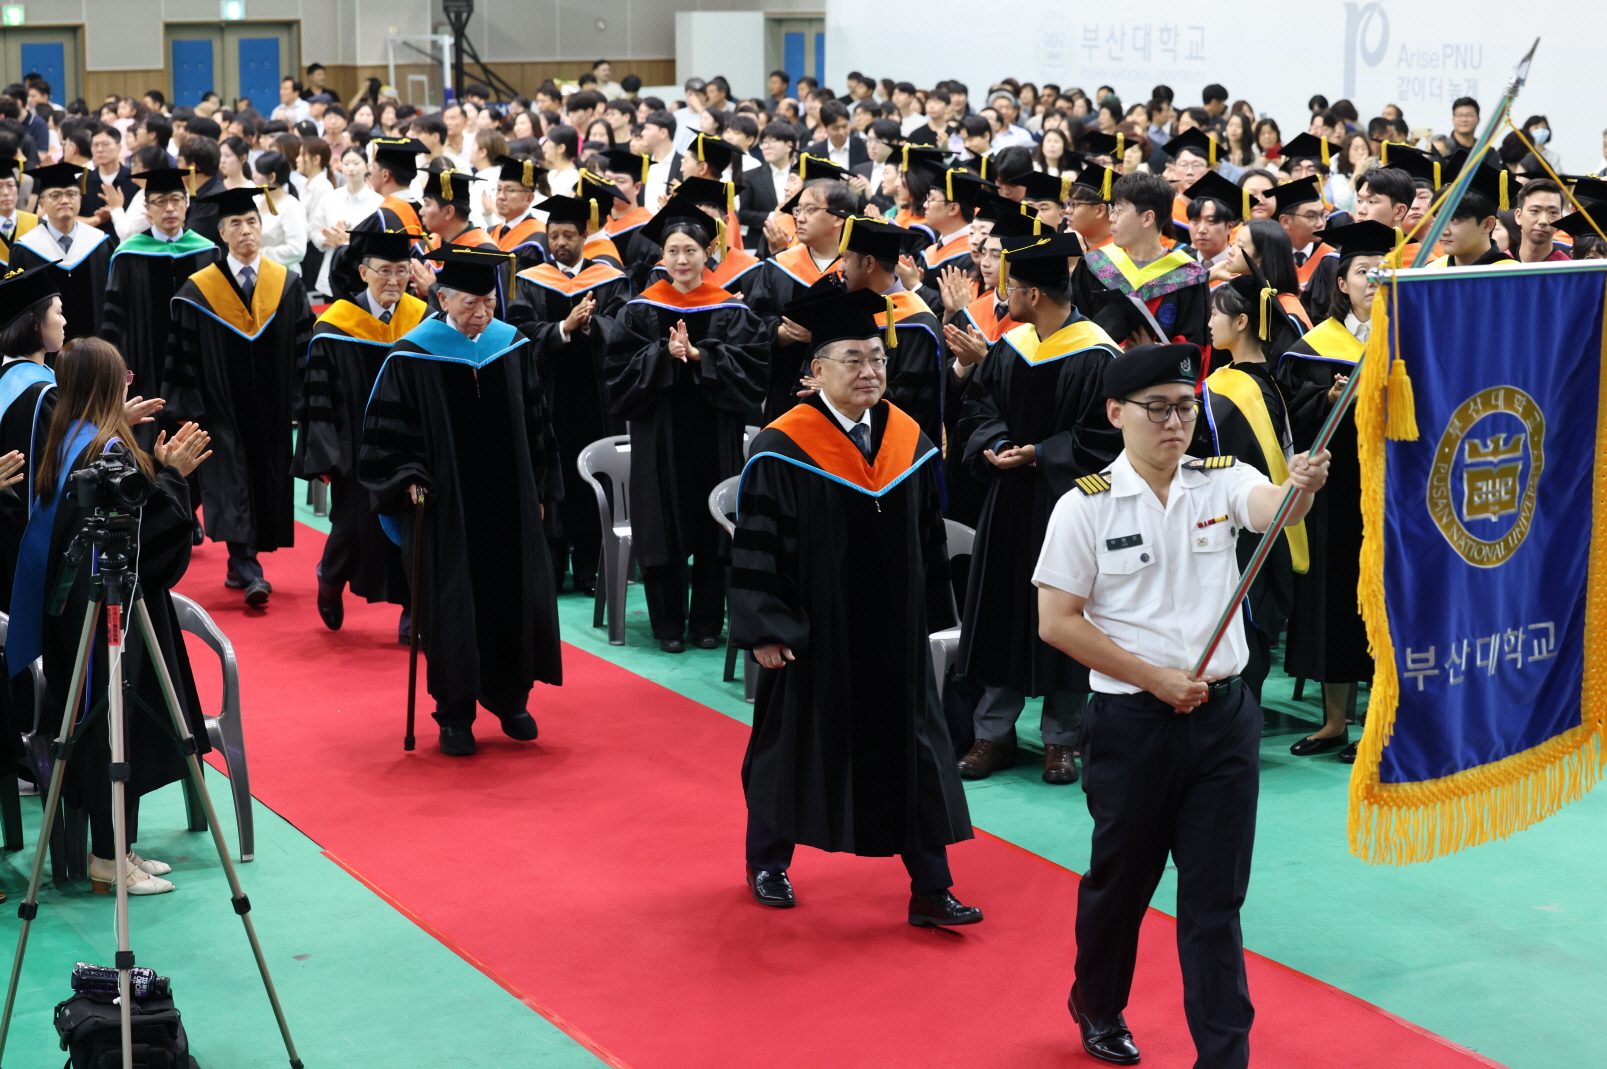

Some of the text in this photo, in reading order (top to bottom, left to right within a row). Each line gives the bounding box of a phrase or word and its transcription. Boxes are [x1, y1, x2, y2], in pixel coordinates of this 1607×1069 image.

[1080, 23, 1206, 63] 부산대학교
[1396, 43, 1483, 70] Arise PNU
[1396, 76, 1426, 102] 같이
[1429, 77, 1443, 102] 더
[1448, 389, 1541, 439] 부산대학교
[1432, 463, 1453, 525] PUSAN
[1448, 524, 1508, 562] NATIONAL
[1403, 621, 1557, 691] 부산대학교
